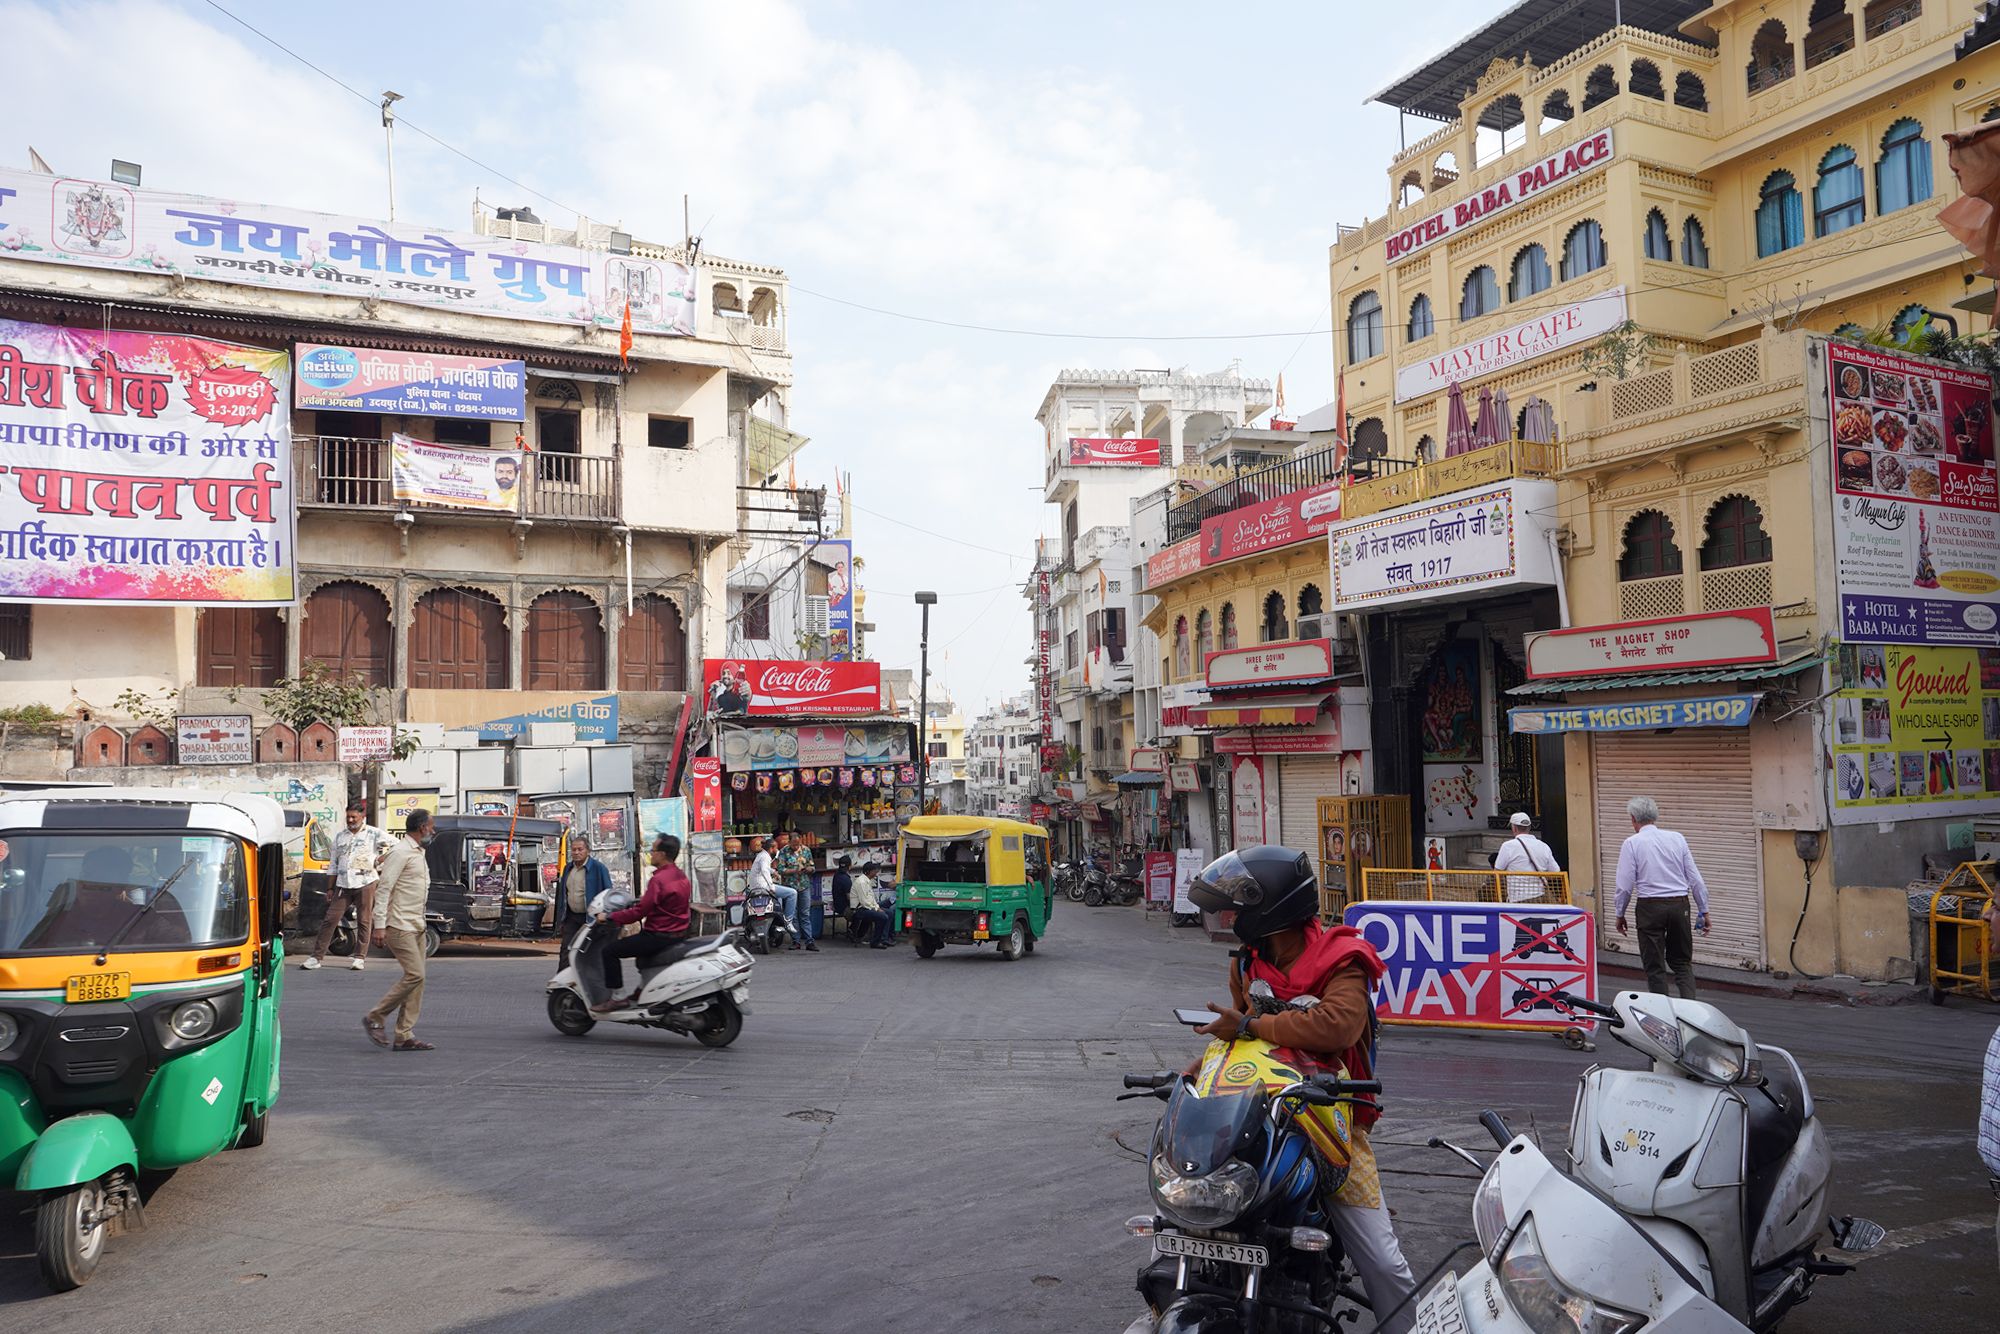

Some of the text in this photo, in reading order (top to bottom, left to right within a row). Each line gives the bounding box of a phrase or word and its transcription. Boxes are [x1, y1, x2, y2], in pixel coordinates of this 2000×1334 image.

[1386, 133, 1609, 260] HOTEL BABA PALACE
[166, 209, 590, 302] जय भोले ग्रुप
[194, 254, 306, 278] जगदीश
[389, 279, 477, 299] उदयपुर
[1428, 307, 1583, 380] MAYUR CAFE
[1444, 335, 1561, 384] ROOF TOP RESTAURANT
[1843, 350, 1856, 359] First
[361, 356, 489, 388] पुलिस जगदीश
[74, 350, 172, 418] चौक
[199, 380, 265, 401] धुलण्डी
[406, 387, 430, 399] पुलिस
[432, 389, 450, 398] थाना
[369, 398, 397, 411] उदयपुर
[142, 431, 190, 456] की
[201, 433, 250, 457] ओर
[254, 433, 280, 458] से
[1104, 441, 1138, 453] Coca-Cola
[11, 466, 186, 521] पावन
[187, 462, 281, 523] पर्व
[1944, 472, 1996, 497] Sai Sagar
[1855, 498, 1887, 525] Mayur
[1945, 496, 1969, 505] coffee
[1979, 501, 1997, 509] more
[1233, 513, 1291, 543] Sai Sagar
[1939, 512, 1992, 526] AN EVENING OF
[1232, 541, 1258, 552] coffee
[1269, 533, 1292, 543] more
[1355, 508, 1487, 561] श्री तेज स्वरूप बिहारी जी
[1850, 532, 1901, 546] Pure Vegetarian
[1936, 525, 1996, 540] DANCE & DINNER
[84, 534, 171, 567] स्वागत
[173, 538, 246, 568] करता
[1874, 548, 1903, 558] Restaurant
[1386, 557, 1452, 586] संवत् 1917
[1864, 601, 1900, 618] HOTEL
[1848, 619, 1917, 636] BABA PALACE
[1590, 628, 1690, 648] THE MAGNET SHOP
[1245, 653, 1285, 664] SHREE GOVIND
[1605, 643, 1673, 660] द मैगनेट शॉप
[759, 665, 835, 692] Coca-Cola
[1897, 655, 1971, 709] Govind
[576, 700, 611, 720] चौक
[1547, 701, 1746, 729] THE MAGNET SHOP
[179, 717, 248, 729] PHARMACY SHOP
[1896, 714, 1979, 728] WHOLSALE-SHOP
[341, 737, 388, 747] AUTO PARKING
[198, 754, 218, 763] GIRLS
[219, 753, 249, 762] SCHOOL
[694, 760, 718, 770] Coca-Cola
[1356, 912, 1489, 963] ONE
[80, 973, 120, 988] RJ27P
[79, 986, 120, 1001] B8563
[1370, 967, 1493, 1016] WAY
[1614, 1140, 1660, 1159] SU914
[1484, 1278, 1500, 1321] HONDA
